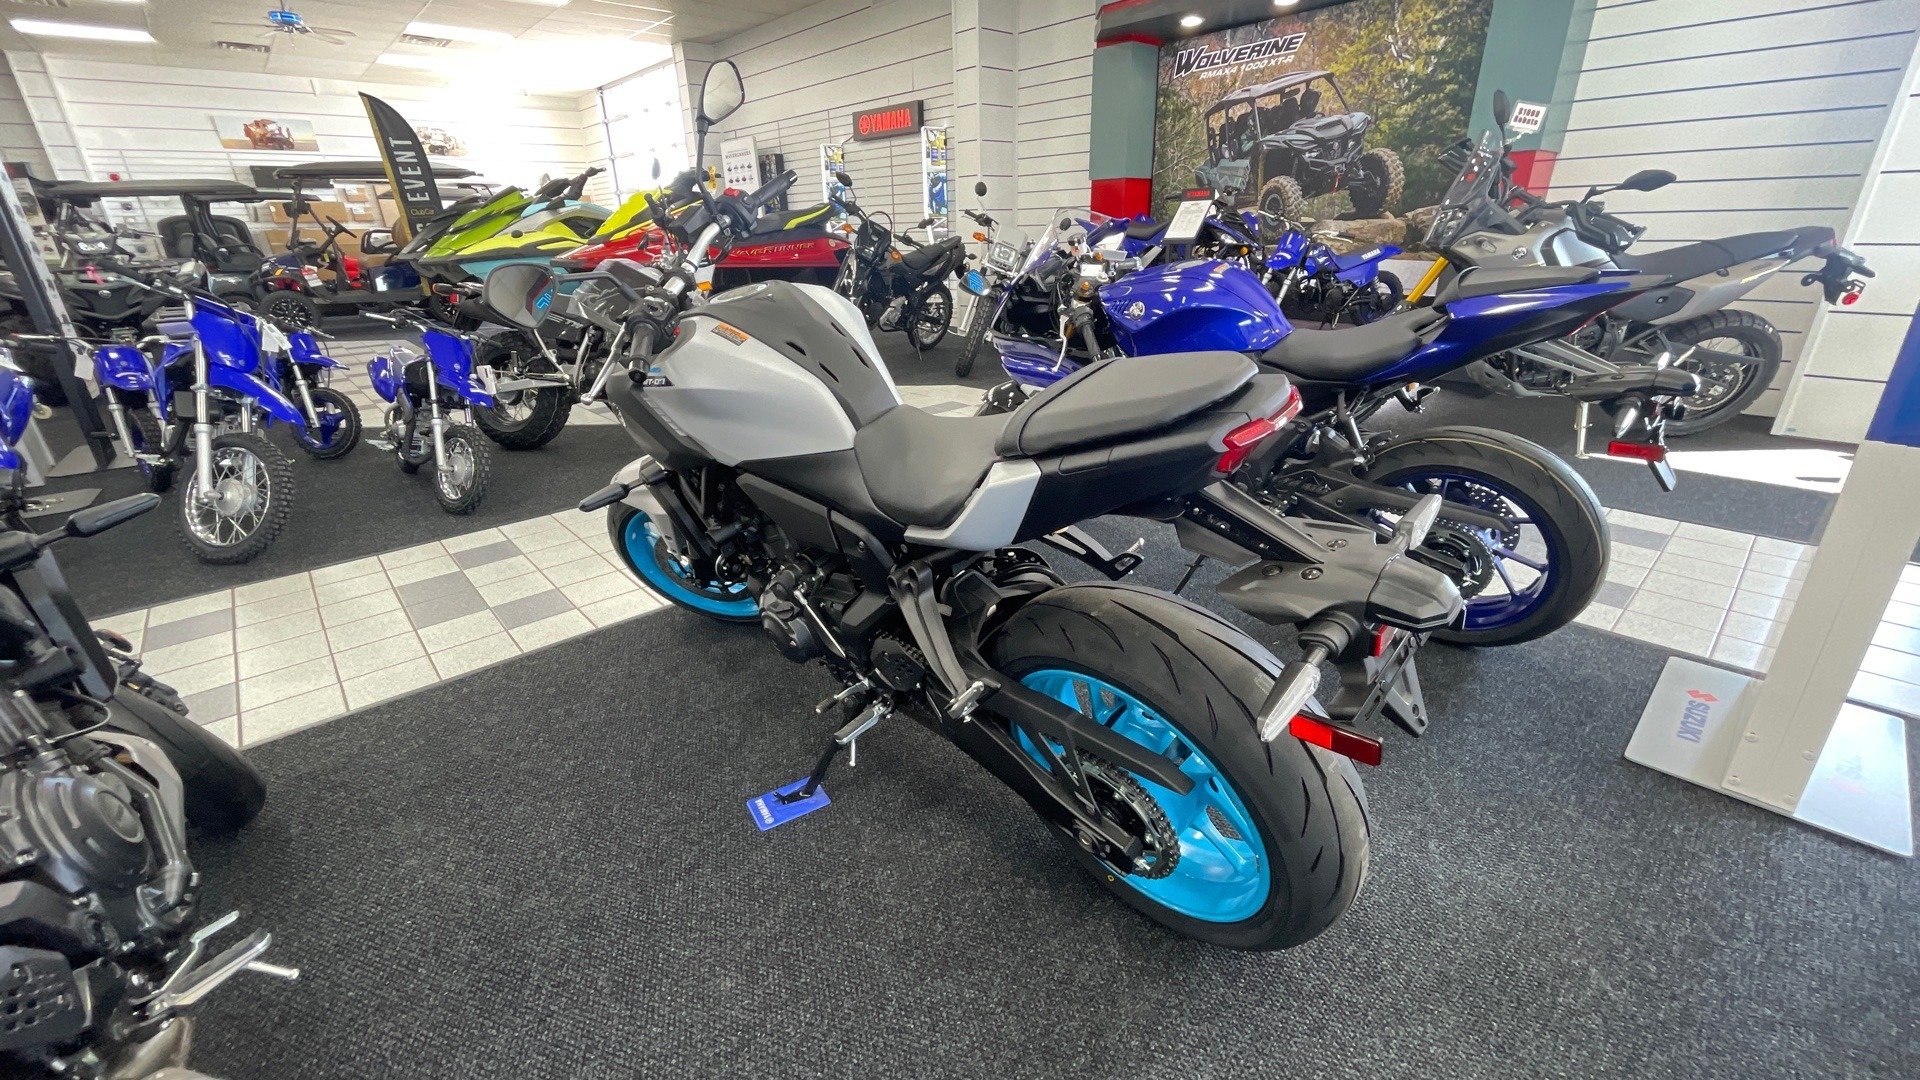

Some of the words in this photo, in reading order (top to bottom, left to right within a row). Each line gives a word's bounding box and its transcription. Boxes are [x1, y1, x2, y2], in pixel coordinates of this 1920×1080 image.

[1174, 32, 1307, 78] WOLVERINE
[1200, 67, 1237, 80] RMAX4
[1240, 59, 1267, 72] 1000
[1268, 54, 1295, 67] XT-R
[870, 107, 912, 132] YAMAHA
[388, 136, 430, 202] EVENT
[1676, 700, 1711, 743] SUZUKI
